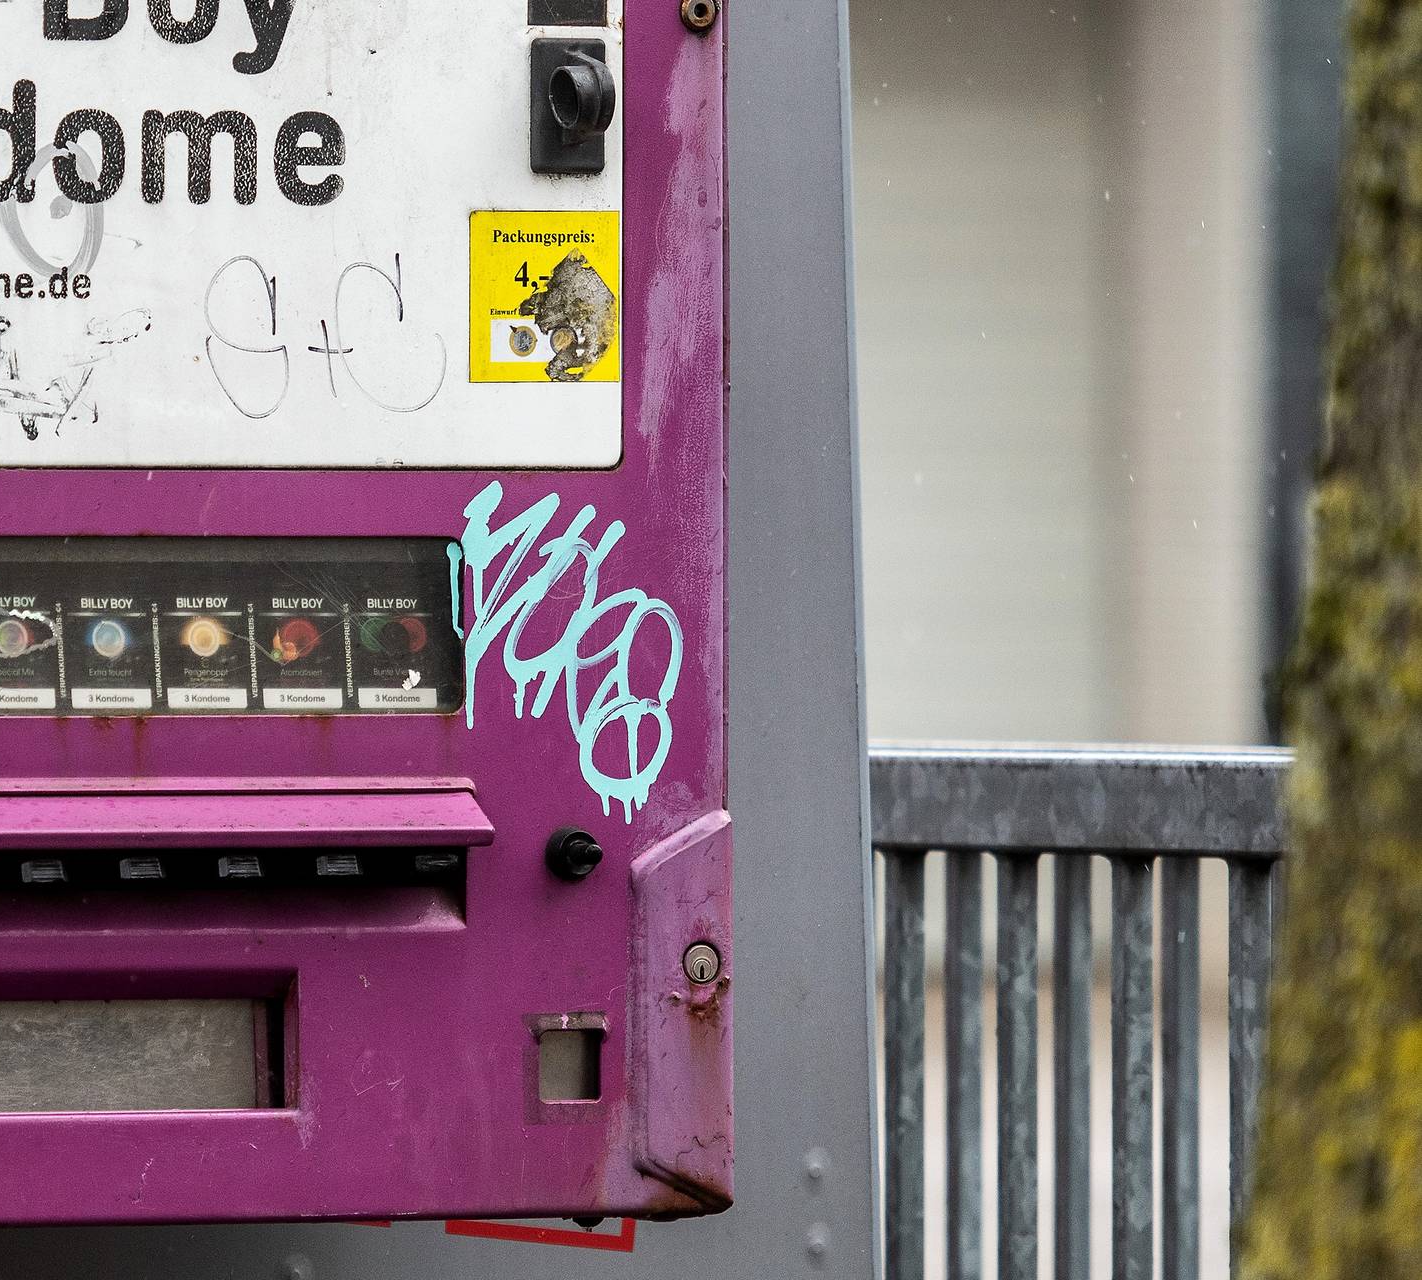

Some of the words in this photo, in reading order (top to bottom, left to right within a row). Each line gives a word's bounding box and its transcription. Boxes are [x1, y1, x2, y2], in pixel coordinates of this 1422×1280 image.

[492, 229, 596, 247] Packungspreis:
[13, 596, 36, 607] BOY
[80, 598, 109, 609] BILLY
[110, 598, 133, 609] BOY
[176, 597, 204, 608] BILLY
[205, 597, 229, 608] BOY
[272, 598, 301, 609] BILLY
[301, 598, 323, 609] BOY
[367, 598, 395, 609] BILLY
[396, 598, 417, 609] BOY
[0, 694, 38, 703] Kondome
[95, 694, 134, 703] Kondome
[191, 694, 230, 703] Kondome
[287, 694, 326, 703] Kondome
[382, 694, 421, 703] Kondome
